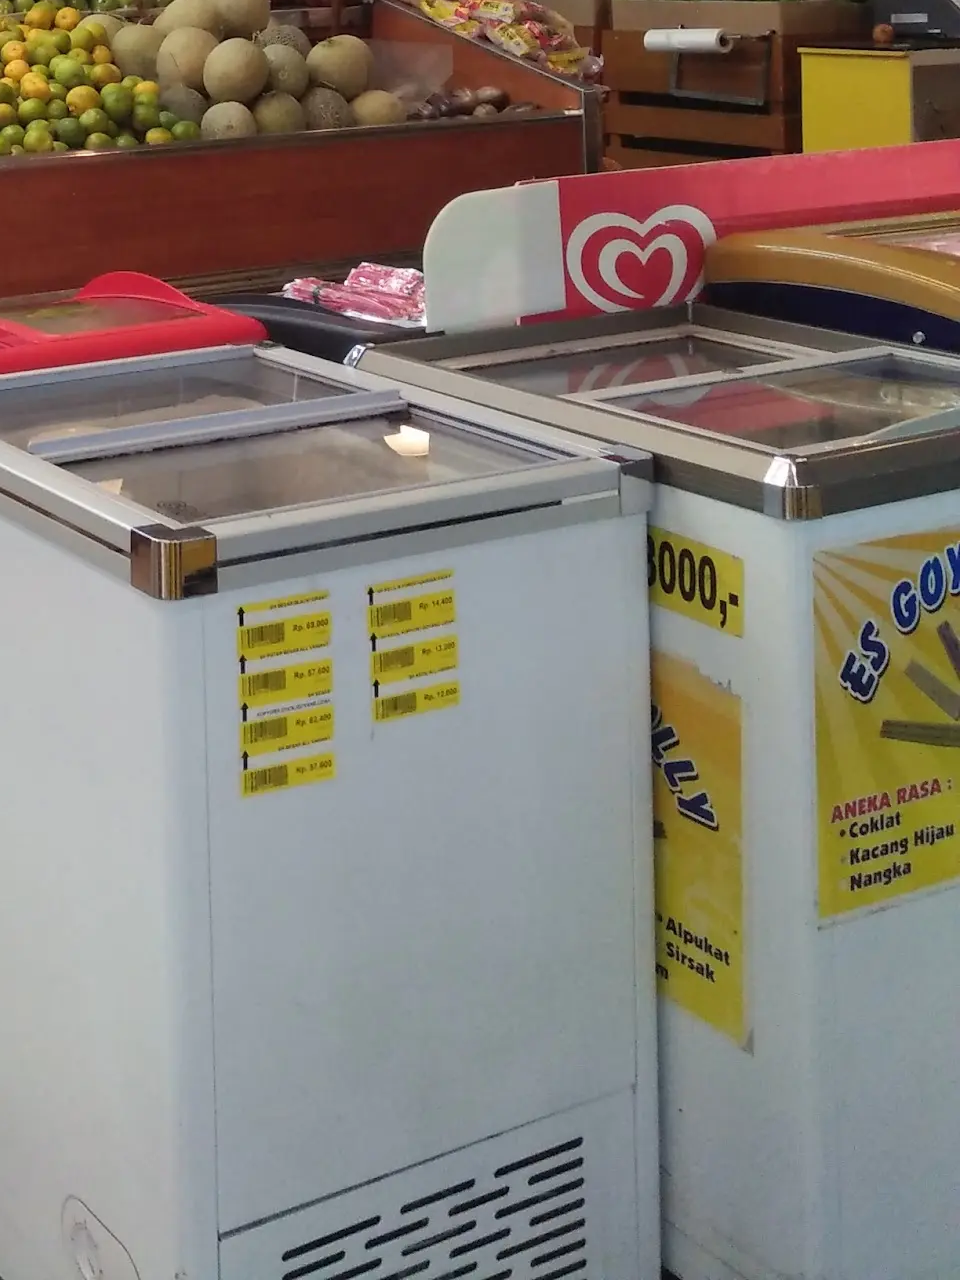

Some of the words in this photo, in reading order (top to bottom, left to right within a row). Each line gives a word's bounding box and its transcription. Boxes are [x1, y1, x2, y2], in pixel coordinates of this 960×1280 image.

[839, 618, 890, 703] ES
[831, 791, 891, 824] ANEKA
[896, 778, 942, 805] RASA
[849, 811, 902, 838] Coklat
[850, 837, 909, 865] Kacang
[914, 824, 954, 847] Hijau
[850, 862, 912, 891] Nangka
[665, 916, 730, 966] Alpukat
[665, 941, 716, 983] Sirsak
